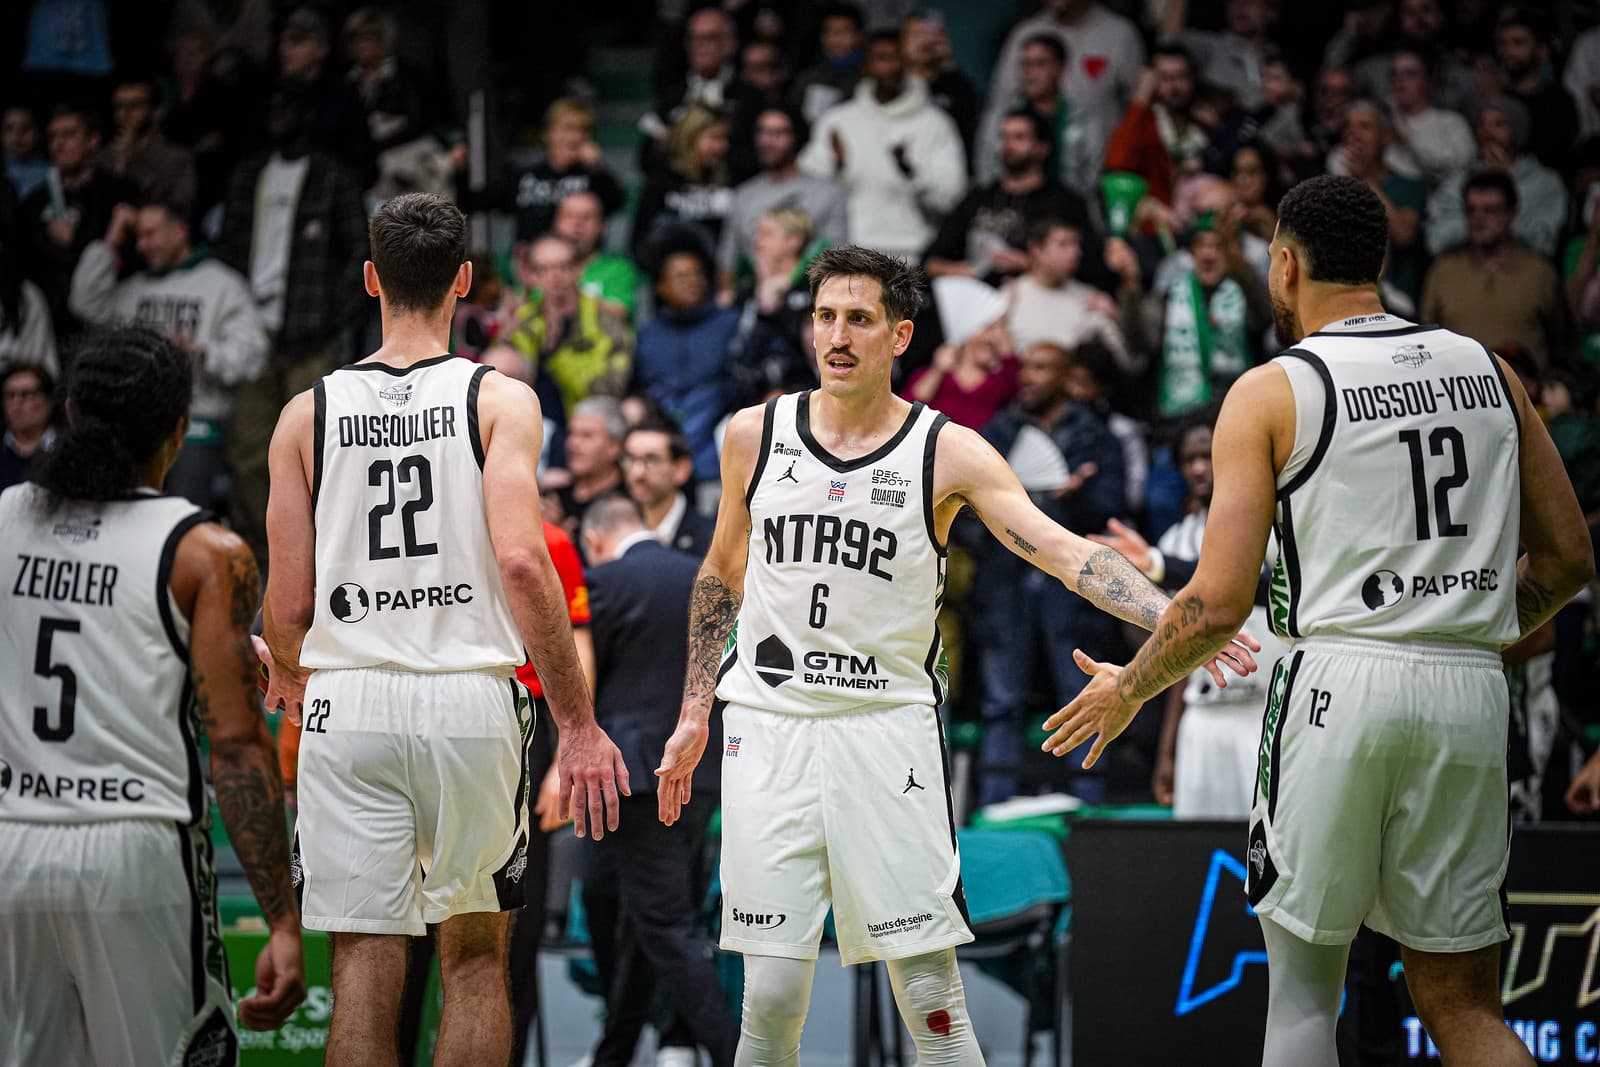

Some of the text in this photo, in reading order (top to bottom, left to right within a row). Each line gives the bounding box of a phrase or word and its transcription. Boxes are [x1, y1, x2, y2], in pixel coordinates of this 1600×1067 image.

[1344, 317, 1367, 327] NIKE
[1342, 375, 1502, 423] DOSSOU-YOVO
[338, 405, 456, 448] DUSSOULIER
[870, 488, 906, 505] QUARTUS
[871, 476, 912, 487] SPORT
[1399, 426, 1469, 541] 12
[368, 454, 438, 561] 22
[827, 494, 844, 503] ELITE
[764, 514, 898, 582] NTR92
[12, 554, 119, 607] ZEIGLER
[1412, 568, 1499, 598] PAPREC
[375, 583, 474, 612] PAPREC
[808, 583, 830, 629] 6
[32, 615, 81, 743] 5
[803, 651, 877, 675] GTM
[804, 672, 889, 690] BÂTIMENT
[305, 698, 331, 734] 22
[1308, 688, 1332, 728] 12
[18, 772, 145, 802] PAPREC
[733, 908, 773, 927] Sepur
